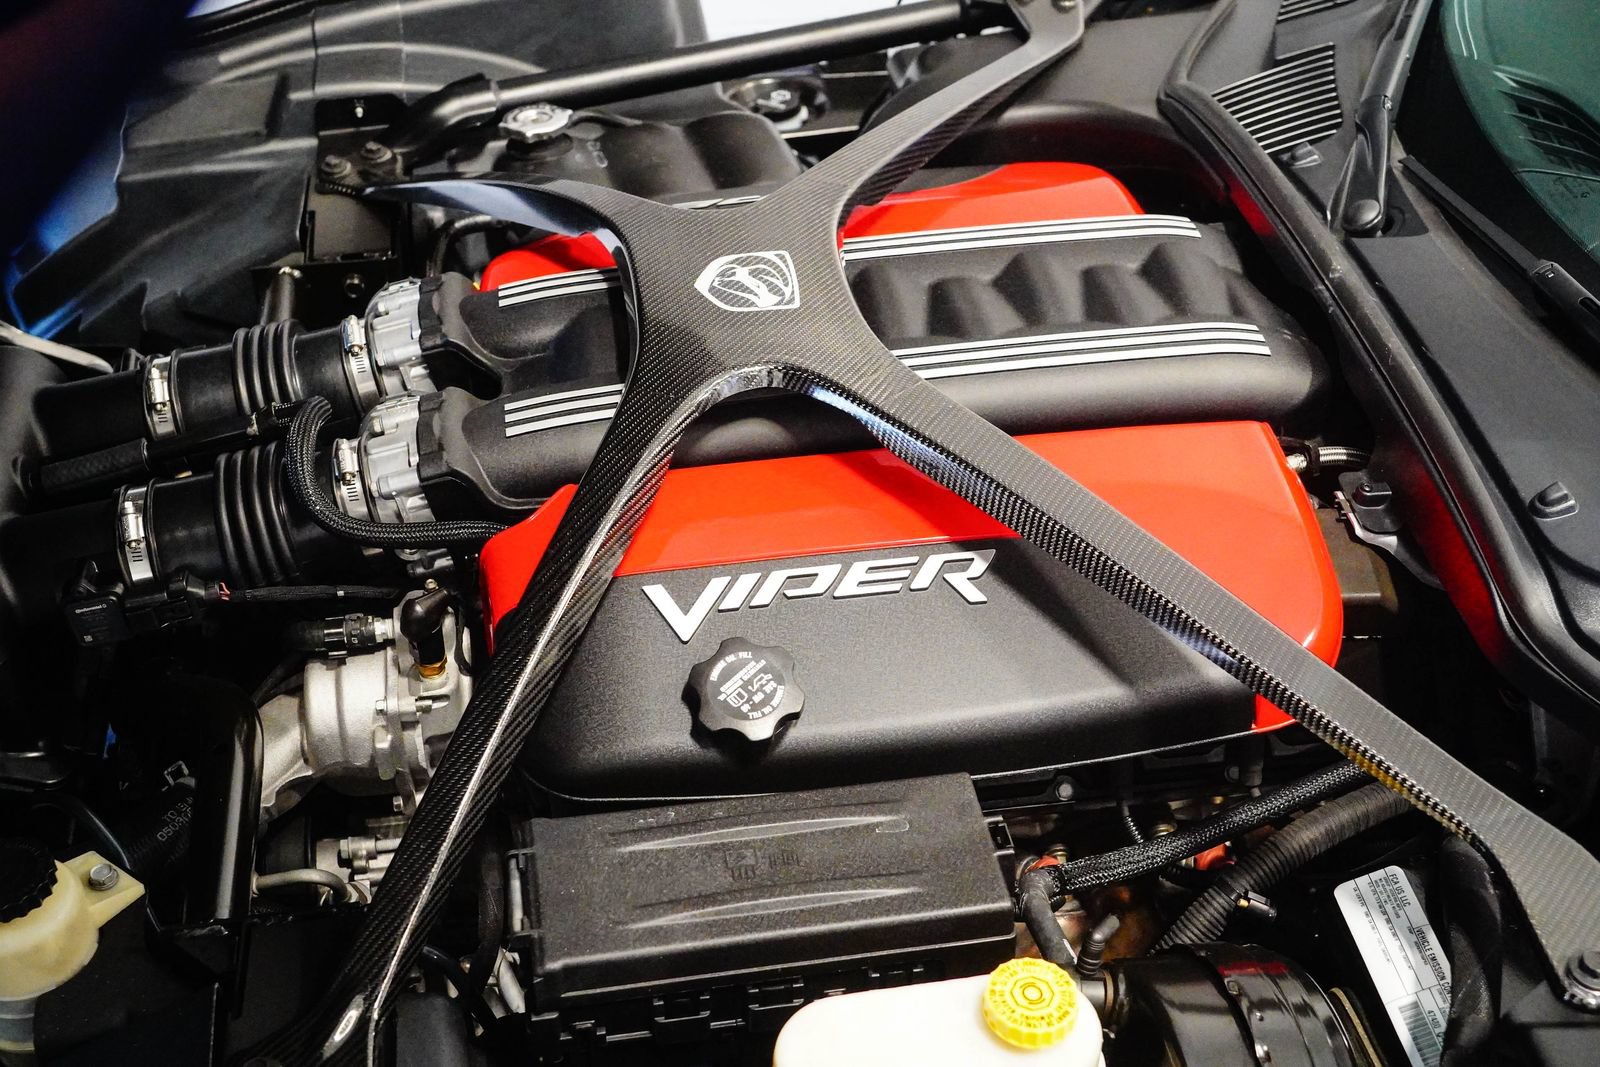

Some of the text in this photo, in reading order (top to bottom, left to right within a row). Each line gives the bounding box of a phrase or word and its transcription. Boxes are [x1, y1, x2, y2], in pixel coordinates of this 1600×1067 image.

[642, 549, 996, 643] VIPER
[725, 654, 737, 663] OIL
[763, 681, 777, 694] SAE
[748, 711, 762, 719] FILL
[762, 705, 773, 715] OIL
[1389, 873, 1412, 909] FCA US LLC
[1416, 927, 1433, 953] VEHICLE
[1428, 950, 1447, 982] EMISSION
